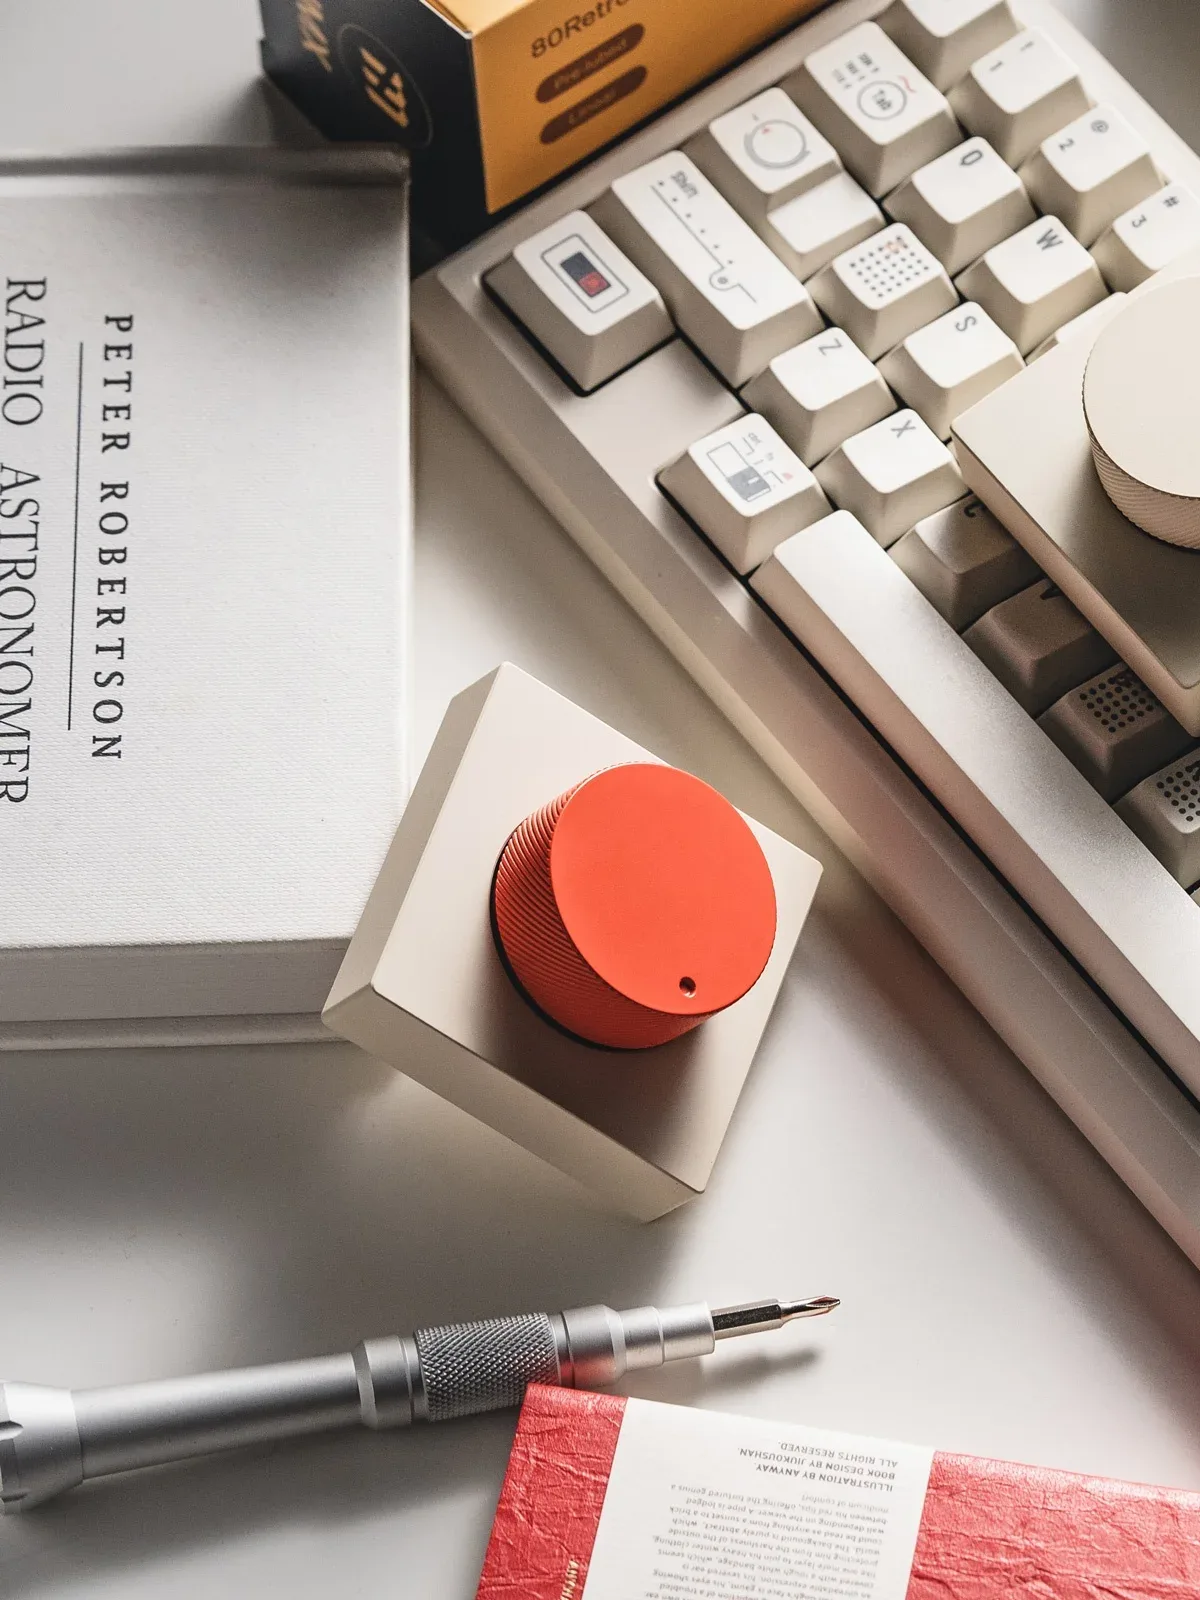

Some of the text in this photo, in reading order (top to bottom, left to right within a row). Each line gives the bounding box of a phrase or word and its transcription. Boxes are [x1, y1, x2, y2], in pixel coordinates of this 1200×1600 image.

[1059, 138, 1074, 151] 2
[959, 149, 984, 166] Q
[1132, 214, 1148, 229] 3
[1036, 228, 1064, 251] W
[955, 315, 977, 332] S
[818, 337, 843, 356] Z
[890, 419, 916, 438] X
[0, 276, 48, 803] RADIO ASTRONOMER
[91, 314, 134, 759] PETER ROBERTSON
[776, 1441, 897, 1468] ALL RIGHTS RESERVED.
[736, 1447, 895, 1480] BOOK DESIGN BY JIUKOUSHAN.
[752, 1462, 893, 1492] ILLUSTRATION BY ANYWAY.
[685, 1496, 715, 1508] lodged
[746, 1496, 760, 1504] the
[762, 1498, 796, 1510] offering
[669, 1506, 690, 1515] brick
[727, 1503, 746, 1513] pipe
[671, 1517, 697, 1527] which
[711, 1513, 739, 1522] sunset
[789, 1514, 803, 1522] the
[849, 1513, 887, 1525] between
[818, 1518, 864, 1532] depending
[866, 1527, 884, 1535] wall
